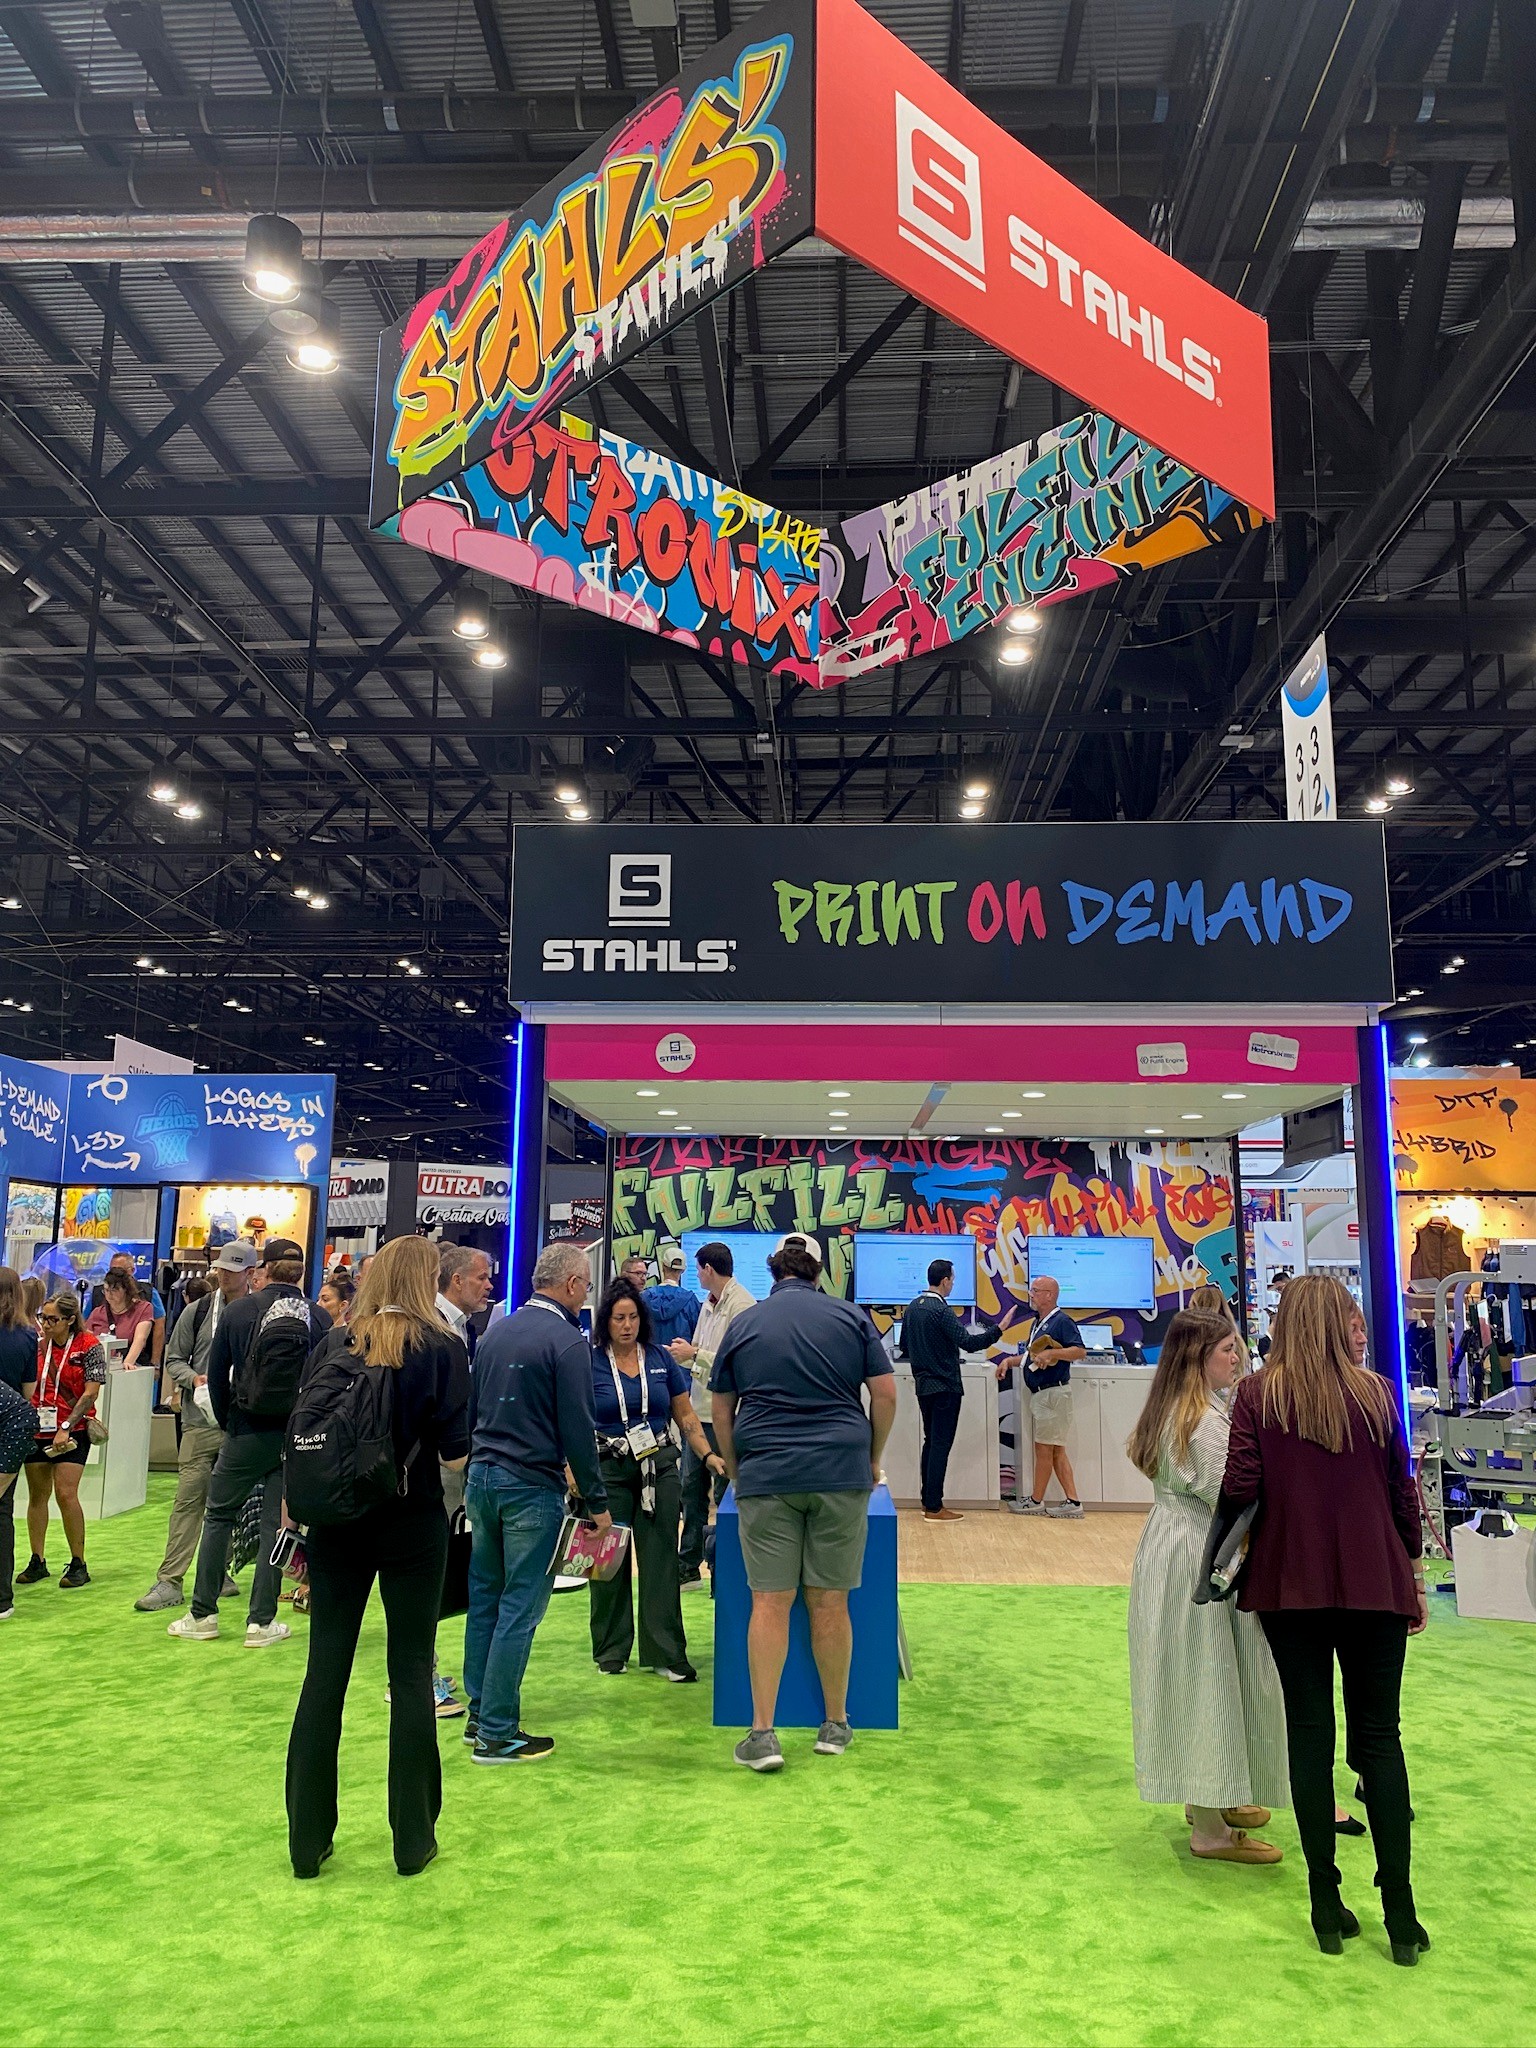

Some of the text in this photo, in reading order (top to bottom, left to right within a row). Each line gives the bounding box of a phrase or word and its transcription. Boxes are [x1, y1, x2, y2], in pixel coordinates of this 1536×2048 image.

[772, 877, 1353, 946] PRINT ON DEMAND
[203, 1084, 325, 1117] LOGOS IN
[1434, 1086, 1497, 1113] DTF
[206, 1106, 315, 1141] LAYERS
[71, 1131, 125, 1153] L3D
[613, 1160, 905, 1237] FULFILL
[422, 1205, 484, 1225] Creative
[573, 1207, 600, 1223] INSPIRED
